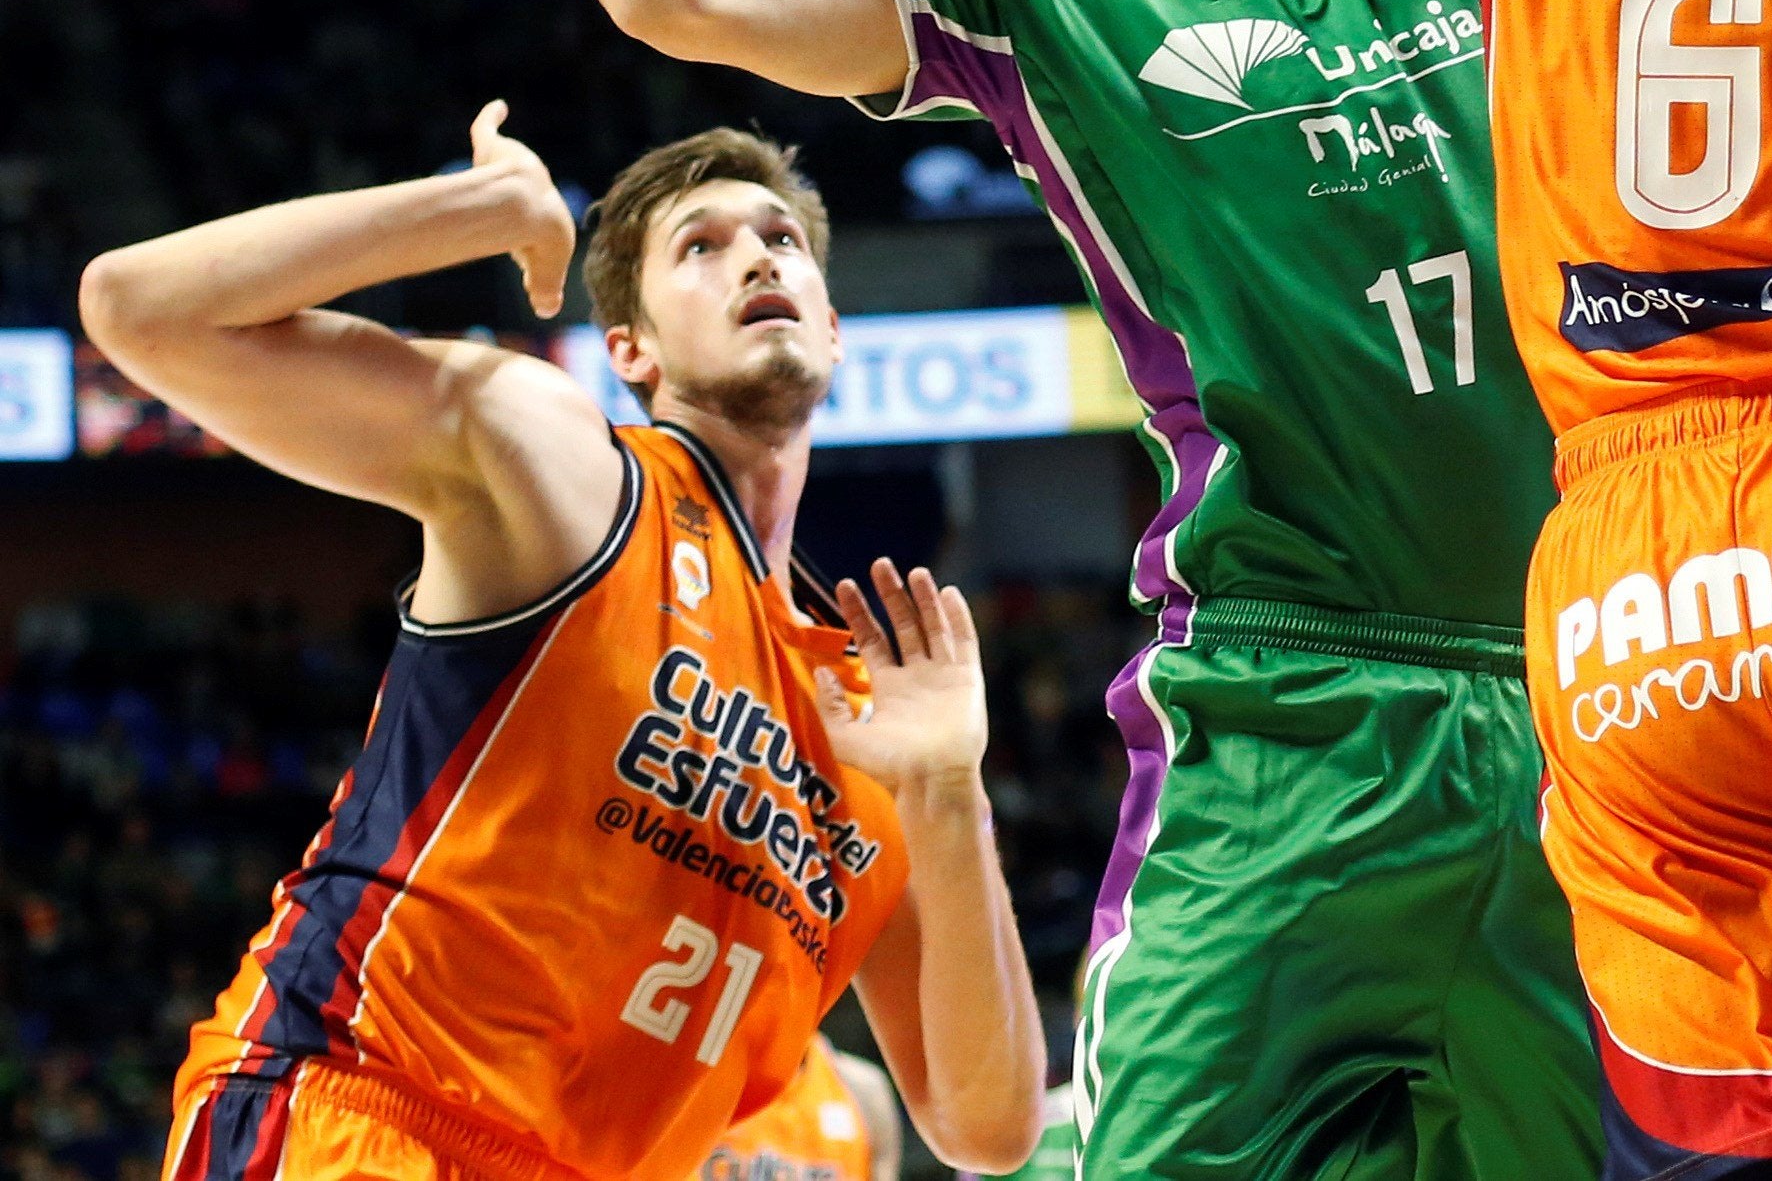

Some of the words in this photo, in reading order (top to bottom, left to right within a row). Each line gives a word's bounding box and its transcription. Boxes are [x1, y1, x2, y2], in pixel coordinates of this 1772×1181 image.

[1308, 178, 1368, 197] Ciudad
[1378, 154, 1431, 186] Genial
[822, 335, 1035, 416] TOS
[1365, 250, 1475, 395] 17
[620, 913, 763, 1067] 21
